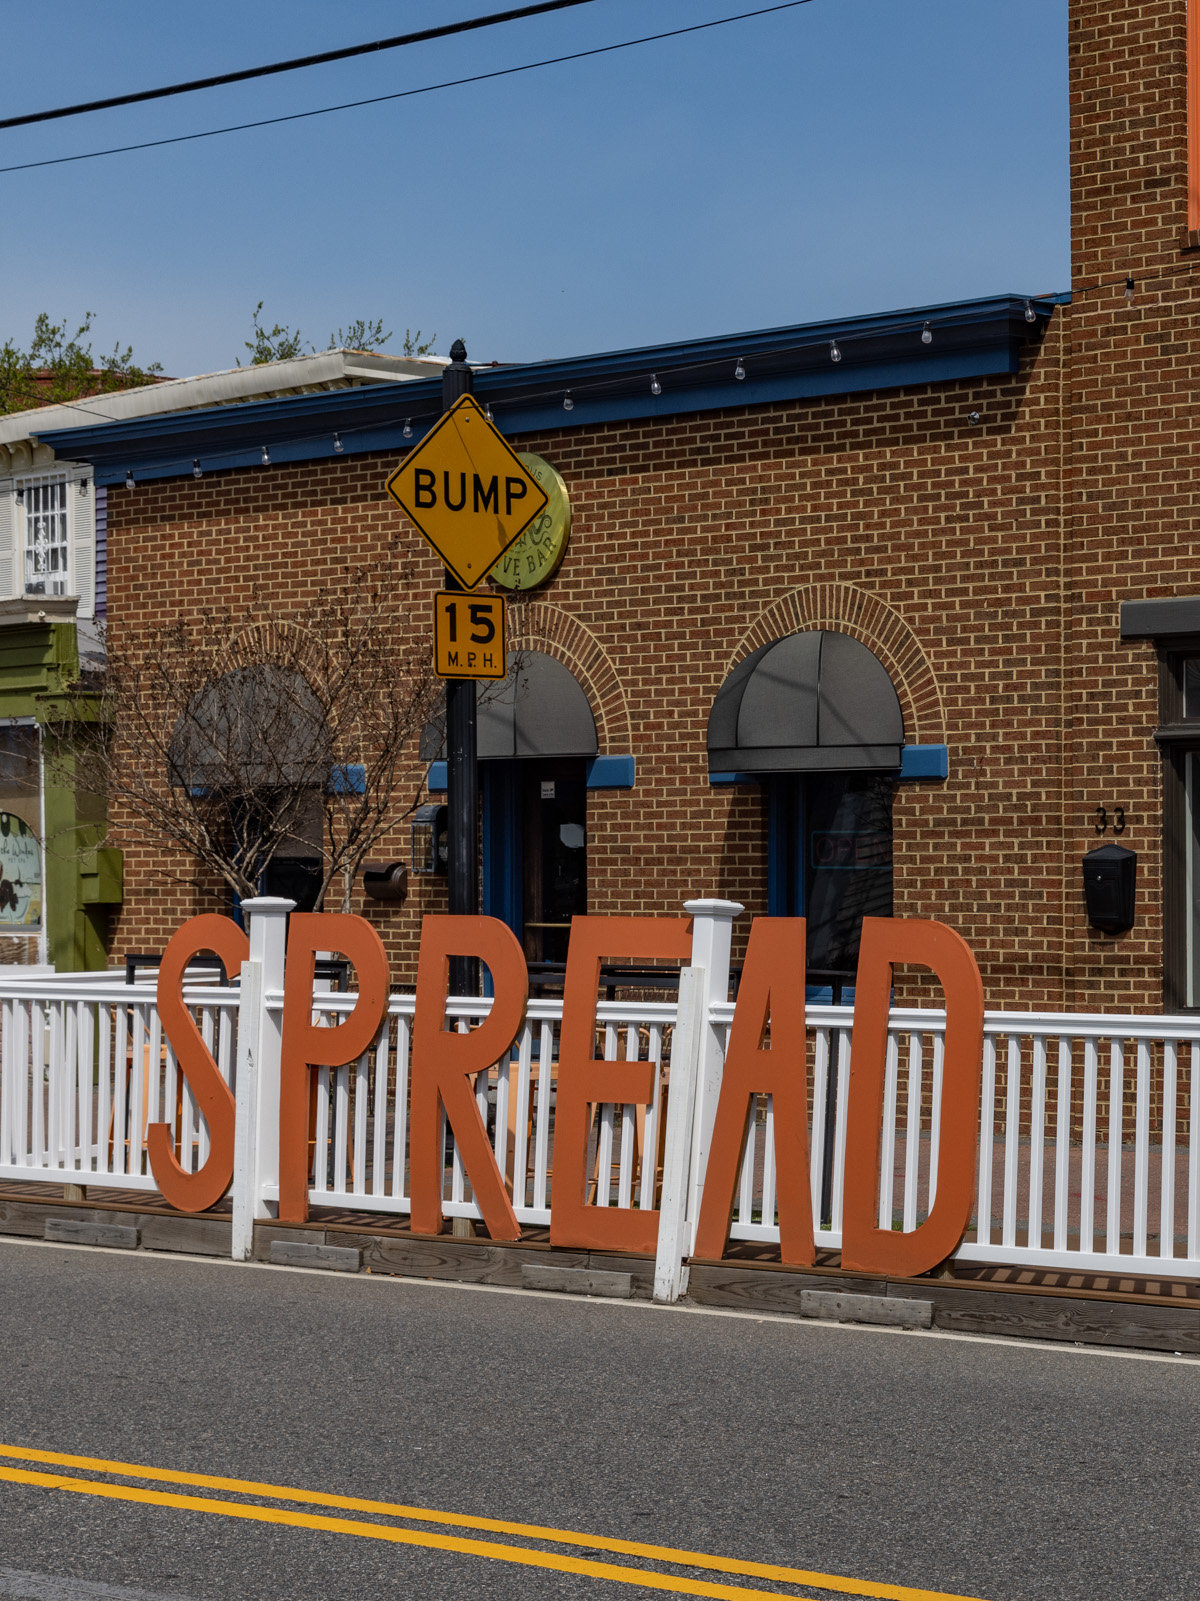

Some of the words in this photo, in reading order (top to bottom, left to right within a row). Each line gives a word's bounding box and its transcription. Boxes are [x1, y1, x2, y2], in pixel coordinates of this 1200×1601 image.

[414, 467, 528, 516] BUMP
[526, 536, 557, 574] BAR
[444, 602, 496, 645] 15
[1095, 807, 1126, 836] 33
[816, 838, 889, 863] OPEN
[148, 912, 985, 1277] SPREAD
